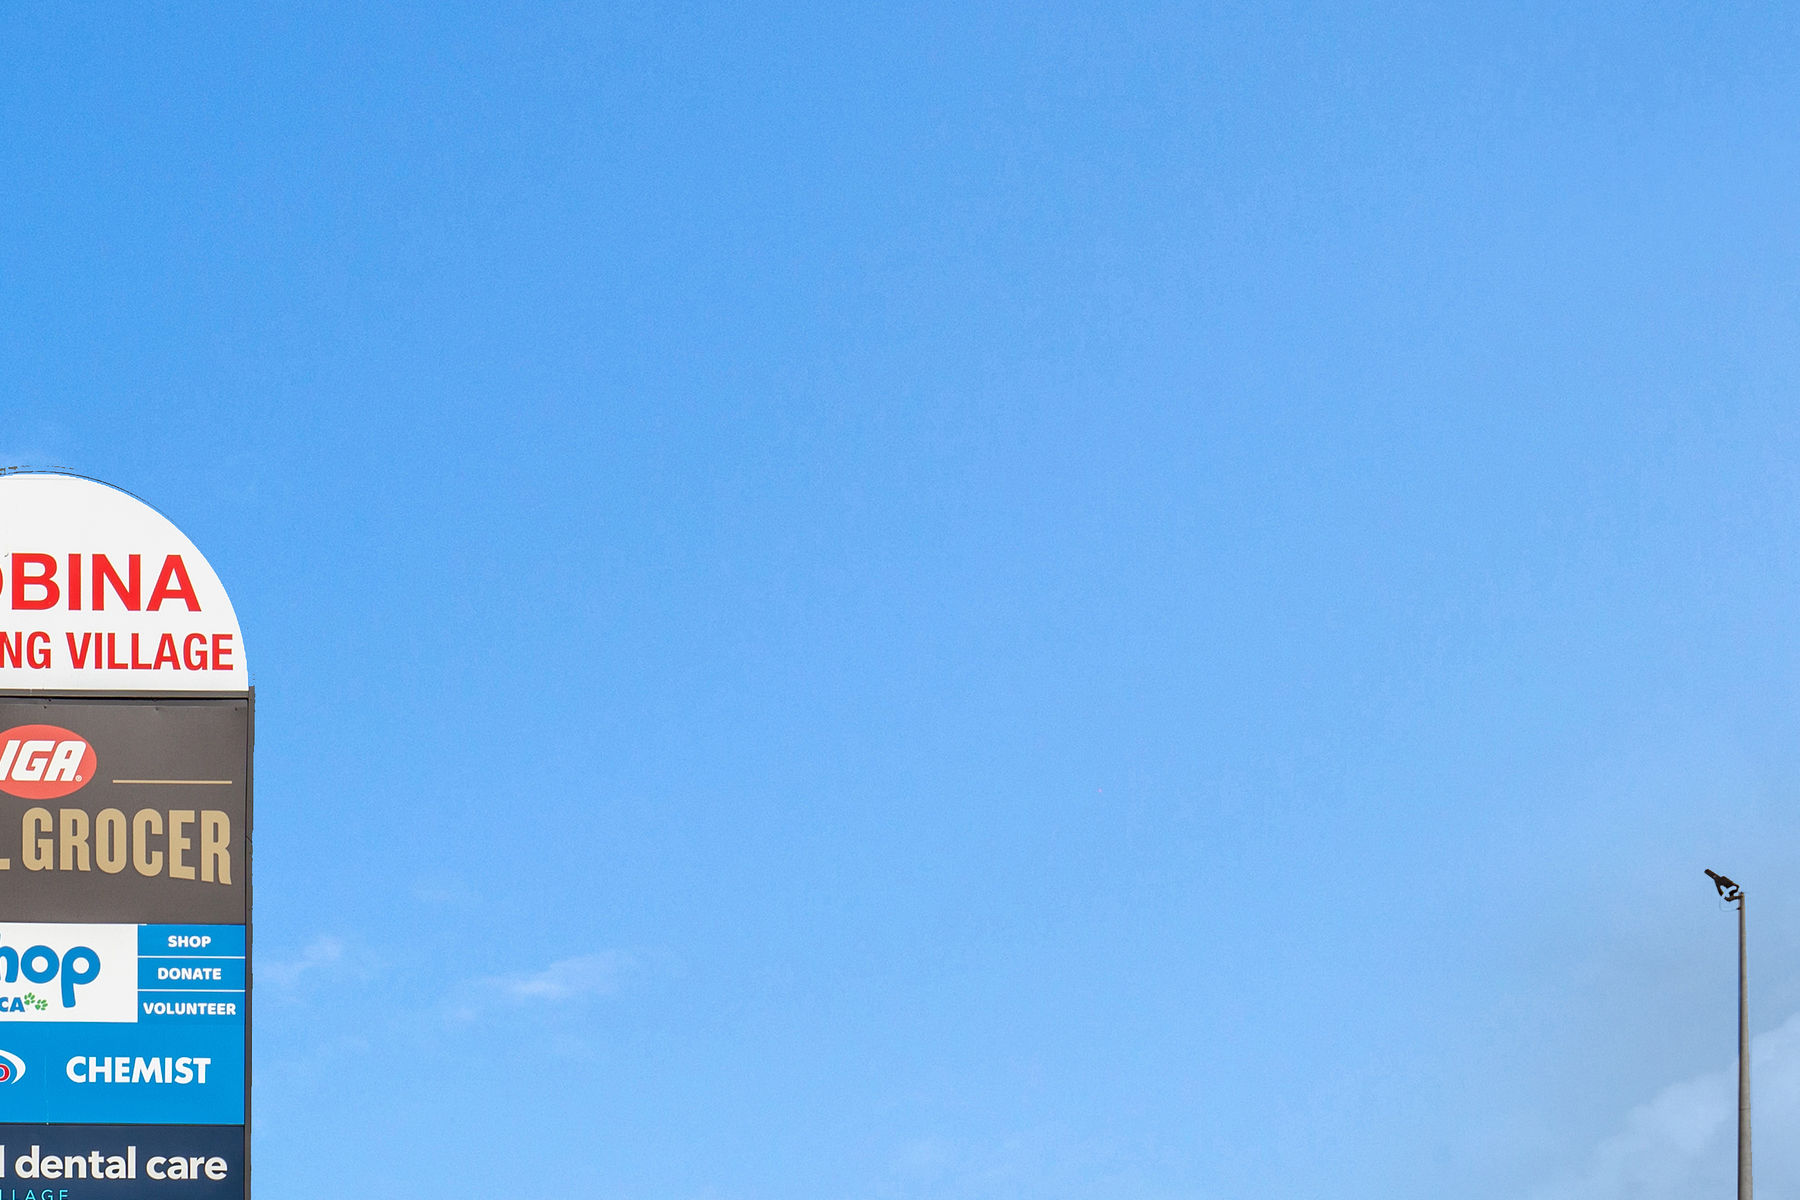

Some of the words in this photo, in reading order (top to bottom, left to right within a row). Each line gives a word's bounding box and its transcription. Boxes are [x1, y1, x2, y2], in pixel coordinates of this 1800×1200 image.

[66, 631, 234, 671] VILLAGE
[21, 806, 233, 886] GROCER
[167, 934, 212, 948] SHOP
[157, 967, 222, 981] DONATE
[143, 1002, 236, 1016] VOLUNTEER
[66, 1056, 212, 1084] CHEMIST
[15, 1146, 136, 1180] dental
[145, 1155, 228, 1181] care
